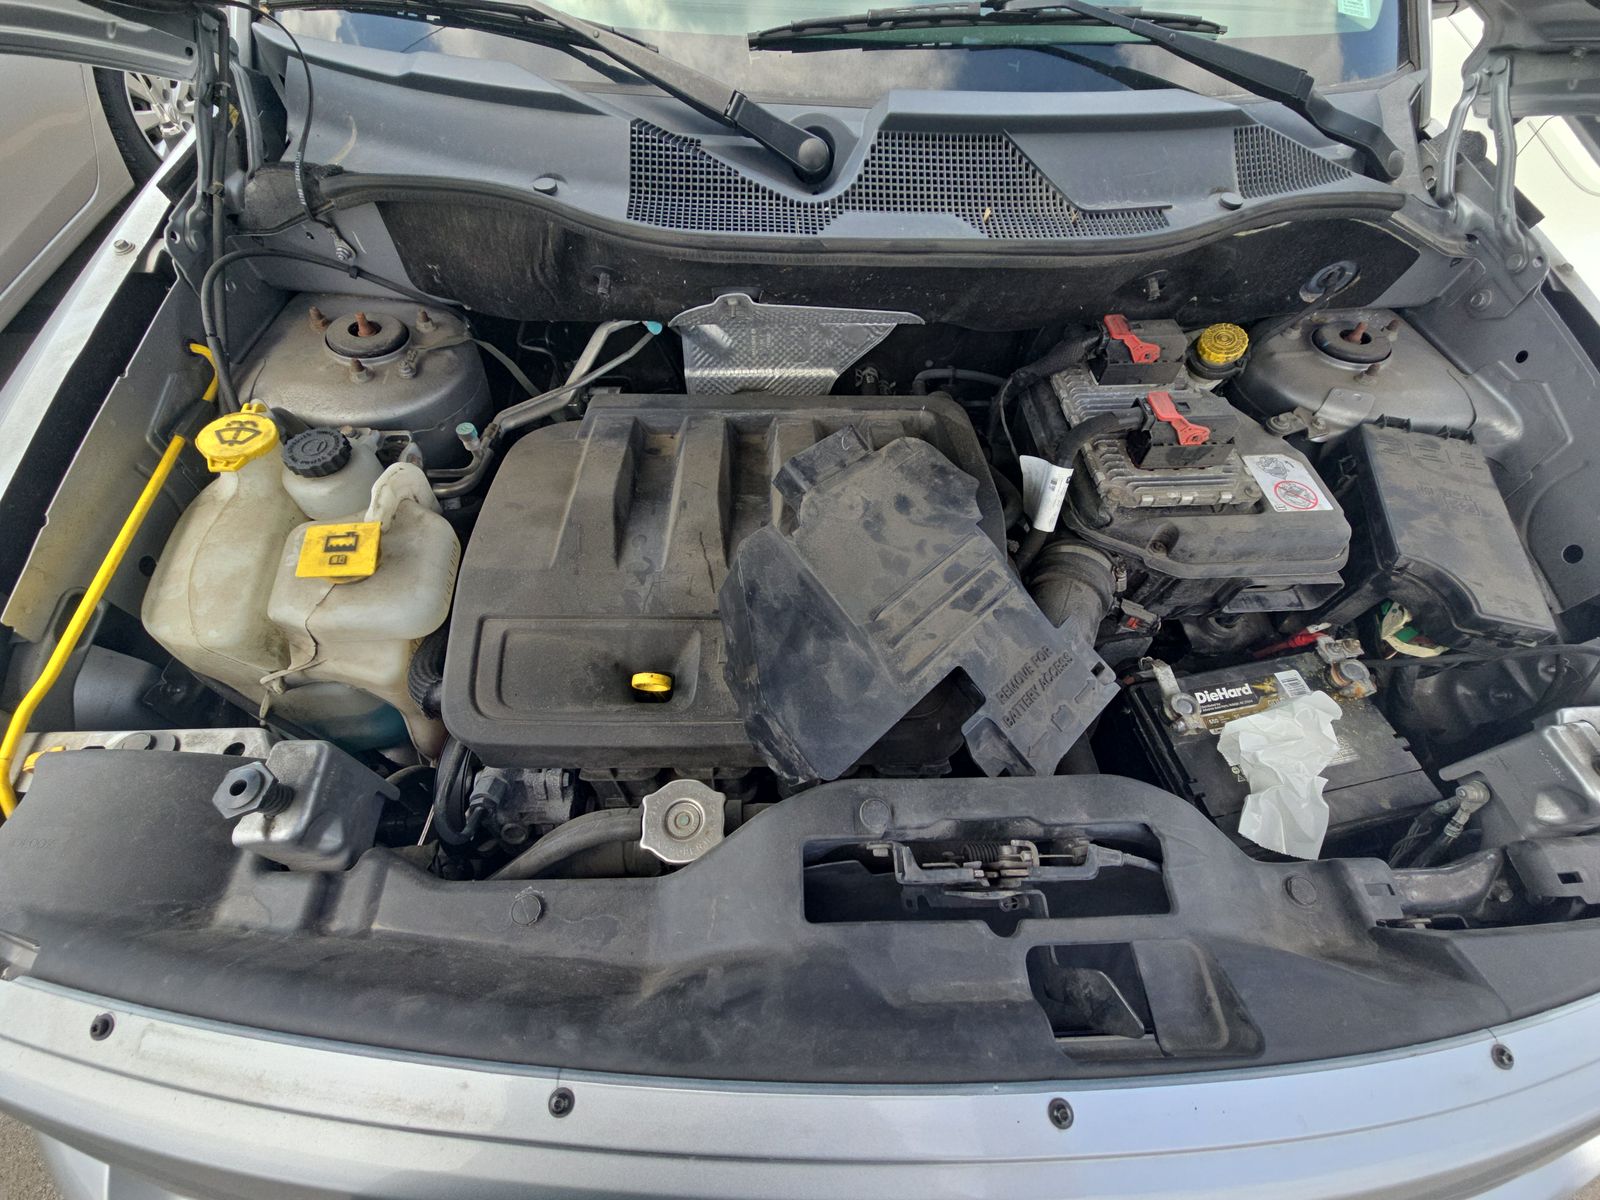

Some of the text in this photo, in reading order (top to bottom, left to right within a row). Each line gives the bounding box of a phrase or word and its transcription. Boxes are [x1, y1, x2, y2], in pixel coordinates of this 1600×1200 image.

[996, 645, 1053, 705] REMOVE FOR
[1002, 652, 1073, 729] BATTERY ACCESS
[1194, 683, 1253, 704] DieHard
